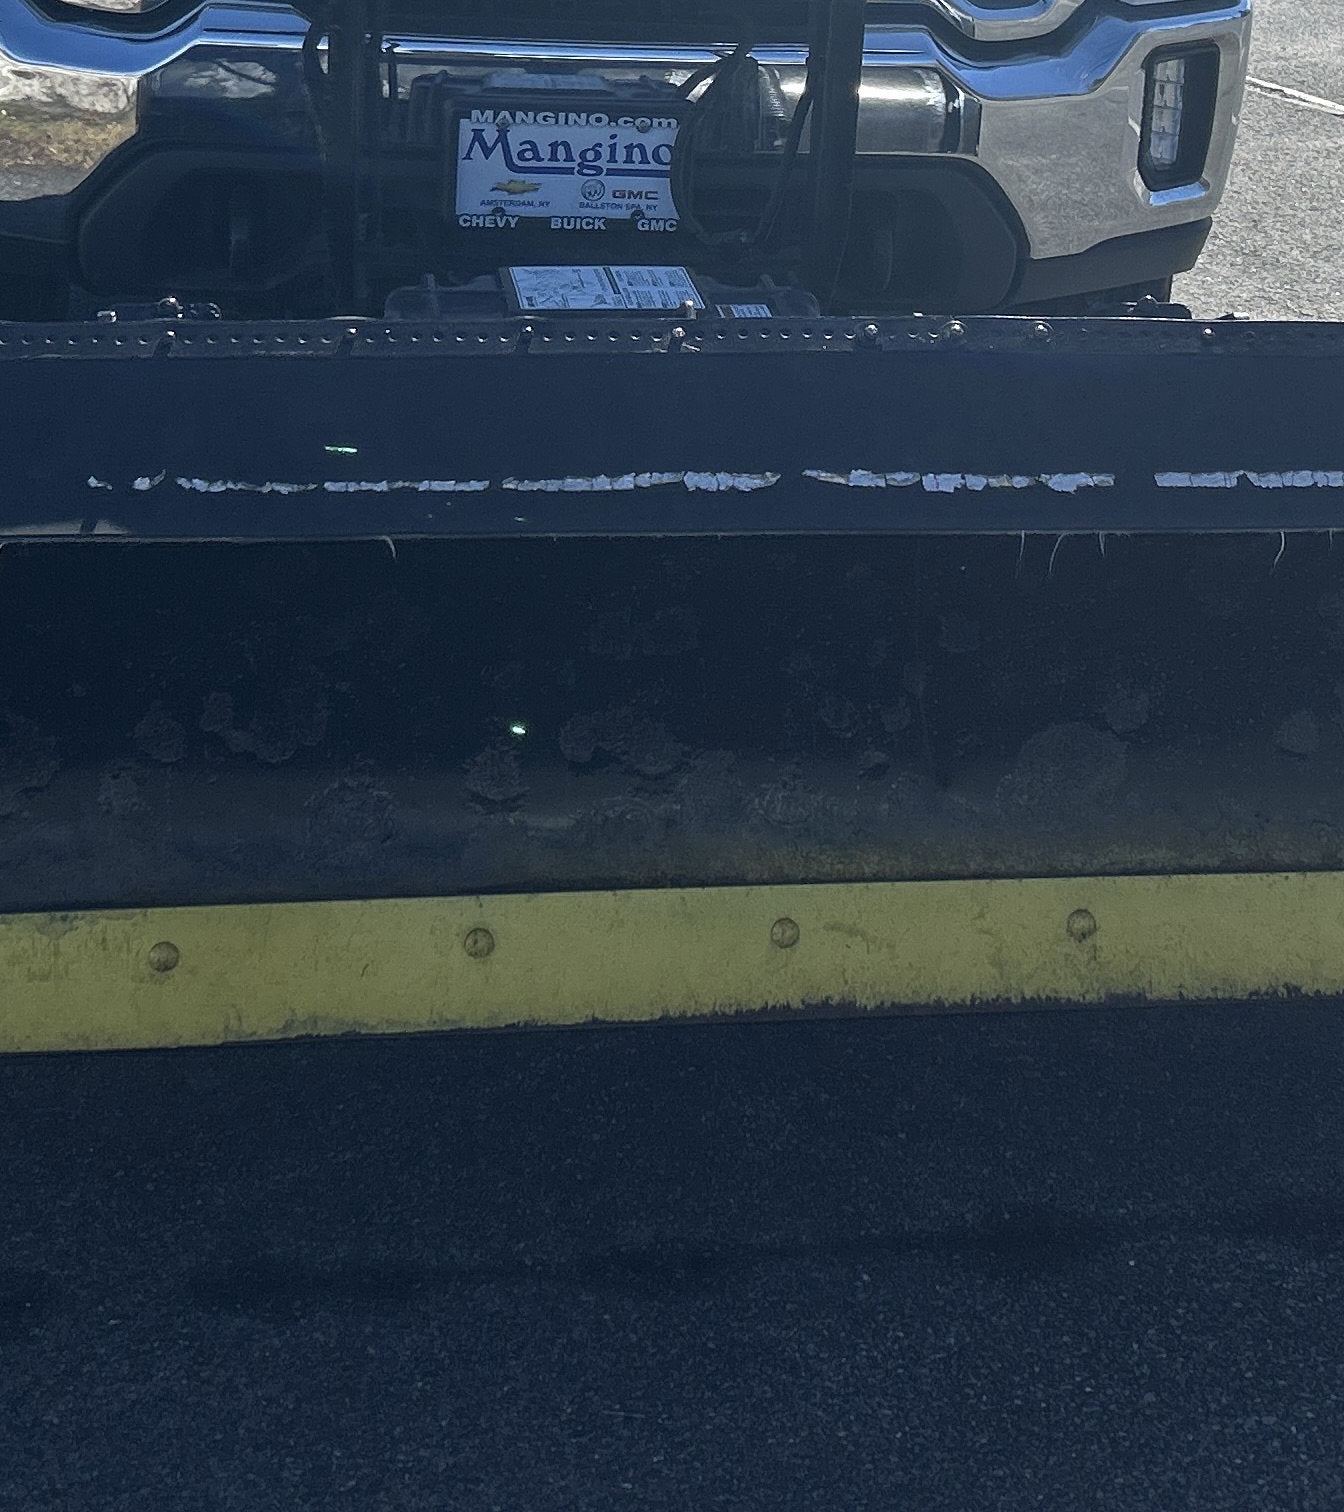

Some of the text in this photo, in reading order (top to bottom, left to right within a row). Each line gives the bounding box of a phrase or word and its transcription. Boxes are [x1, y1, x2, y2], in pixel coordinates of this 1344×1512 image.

[471, 109, 677, 129] MANGINO.com
[462, 128, 673, 176] Mangino
[612, 189, 659, 201] GMC
[538, 200, 551, 208] NY
[579, 201, 623, 210] BALLSTON
[645, 203, 658, 211] NY
[459, 214, 678, 232] CHEVY BUICK GMC
